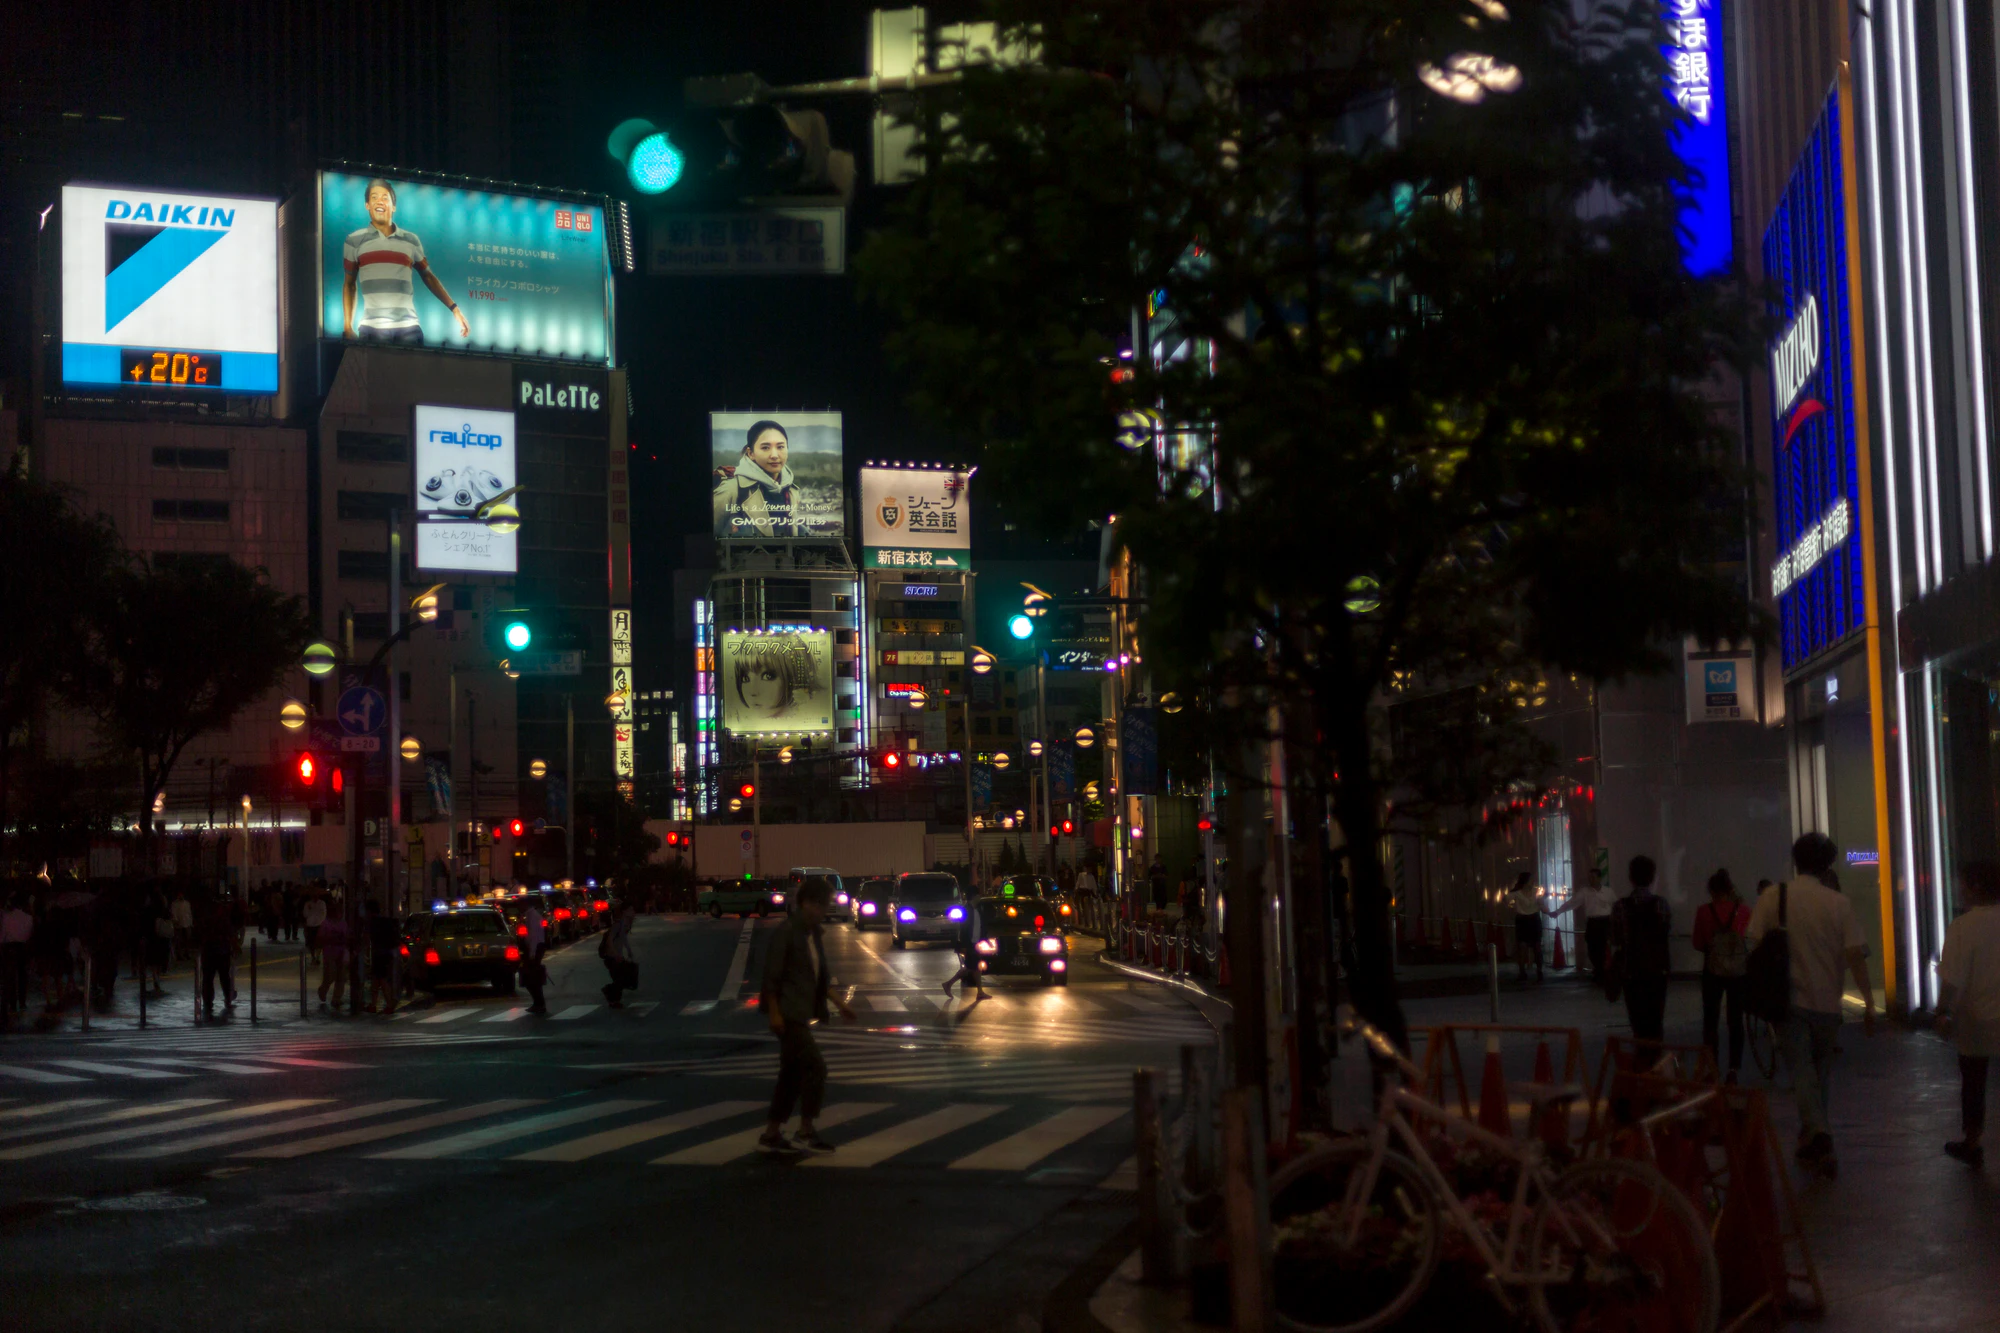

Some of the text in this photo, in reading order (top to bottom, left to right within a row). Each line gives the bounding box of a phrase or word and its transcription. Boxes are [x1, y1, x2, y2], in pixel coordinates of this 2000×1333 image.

[105, 200, 236, 227] DAIKIN
[467, 276, 560, 294] ドライカノコポロシャツ
[1774, 296, 1820, 420] MIZUHO
[429, 424, 502, 450] raycop
[725, 503, 741, 512] Life
[760, 500, 797, 517] Journey
[908, 495, 957, 510] シェーン
[731, 517, 827, 526] GMOクリック証券
[909, 510, 958, 528] 英会話
[430, 529, 503, 542] ふとんクリーナー
[877, 549, 933, 566] 新宿本校
[727, 641, 822, 656] ワクワクメール
[886, 654, 897, 662] 7F
